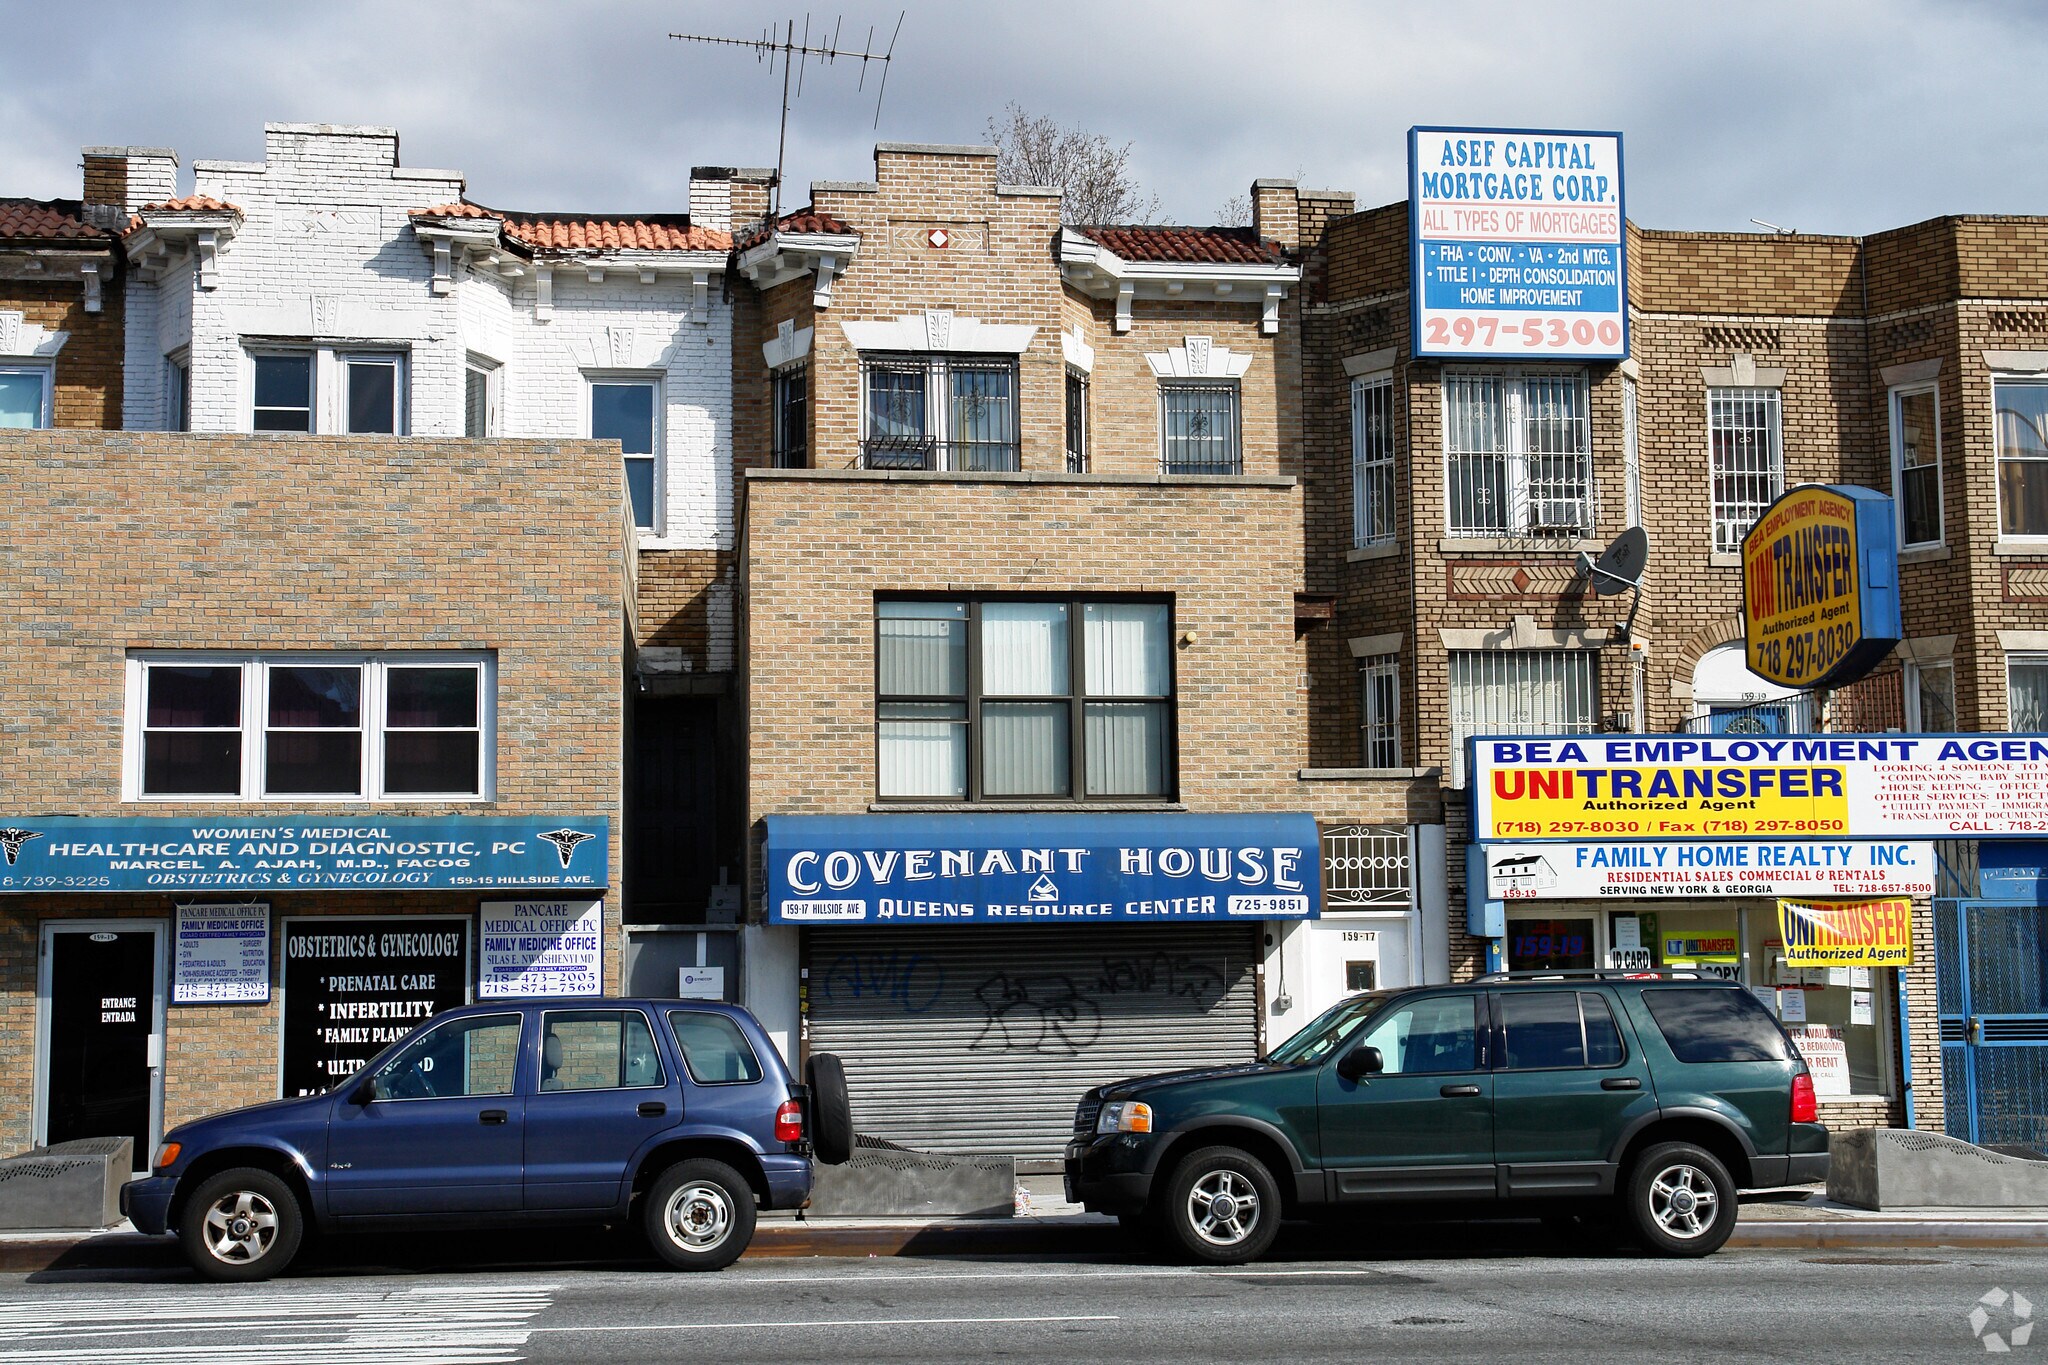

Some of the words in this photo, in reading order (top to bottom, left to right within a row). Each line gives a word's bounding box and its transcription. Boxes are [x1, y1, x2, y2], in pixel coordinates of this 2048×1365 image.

[1440, 139, 1496, 167] ASEF
[1504, 141, 1595, 170] CAPITAL
[1421, 172, 1543, 200] MORTGAGE
[1552, 174, 1616, 203] CORP.
[1423, 209, 1449, 231] ALL
[1453, 210, 1499, 233] TYPES
[1505, 211, 1524, 233] OF
[1530, 211, 1617, 235] MORTGAGES
[1440, 246, 1464, 262] FHA
[1477, 246, 1515, 263] CONV.
[1528, 247, 1544, 263] VA
[1557, 248, 1579, 265] 2nd
[1583, 248, 1611, 265] MTG.
[1437, 266, 1468, 283] TITLE
[1489, 267, 1520, 284] DEPTH
[1523, 268, 1616, 286] CONSOLIDATION
[1460, 288, 1495, 304] HOME
[1500, 289, 1583, 306] IMPROVEMENT
[1425, 316, 1621, 347] 297-5300
[1749, 534, 1765, 555] BEA
[1765, 500, 1816, 537] EMPLOYMENT
[1818, 500, 1850, 523] AGENCY
[1749, 524, 1853, 622] UNITRANSFER
[1762, 611, 1815, 636] Authorized
[1820, 602, 1850, 621] Agent
[1756, 639, 1781, 676] 718
[1785, 621, 1854, 679] 297-8030
[1493, 742, 1588, 763] BEA
[1606, 741, 1919, 762] EMPLOYMENT
[1937, 741, 2048, 761] AGEN
[1874, 764, 1932, 772] LOOKING
[1951, 763, 2015, 772] SOMEONE
[2021, 763, 2038, 771] TO
[1888, 773, 1962, 781] COMPANIONS
[1494, 768, 1843, 800] UNITRANSFER
[1889, 783, 1925, 791] HOUSE
[1931, 783, 1981, 791] KEEPING
[2000, 782, 2040, 790] OFFICE
[1874, 793, 1920, 801] OTHER
[1926, 792, 1989, 800] SERVICES:
[1996, 792, 2010, 800] ID
[1583, 800, 1688, 810] Authorized
[1699, 800, 1756, 811] Agent
[1938, 802, 1986, 810] PAYMENT
[1891, 812, 1962, 820] TRANSLATION
[192, 827, 295, 839] WOMEN'S
[301, 828, 391, 839] MEDICAL
[1496, 821, 1542, 835] (718)
[1549, 821, 1639, 832] 297-8030
[1659, 821, 1695, 832] Fax
[1703, 820, 1748, 834] (718)
[1754, 820, 1843, 831] 297-8050
[49, 843, 231, 856] HEALTHCARE
[237, 842, 299, 856] AND
[309, 842, 481, 857] DIAGNOSTIC,
[491, 842, 526, 855] PC
[1576, 846, 1668, 867] FAMILY
[1678, 846, 1748, 867] HOME
[1758, 845, 1853, 867] REALTY
[1870, 844, 1916, 866] INC.
[109, 860, 205, 870] MARCEL
[218, 860, 240, 869] A.
[254, 859, 322, 871] AJAH,
[335, 858, 388, 870] M.D.,
[396, 858, 471, 868] FACOG
[786, 848, 1090, 895] COVENANT
[1119, 847, 1304, 892] HOUSE
[147, 872, 272, 885] OBSTETRICS
[276, 872, 292, 885] &
[297, 871, 434, 884] GYNECOLOGY
[449, 876, 493, 885] 159-15
[497, 876, 560, 885] HILLSIDE
[564, 875, 595, 884] AVE.
[1607, 872, 1692, 883] RESIDENTIAL
[1695, 871, 1734, 882] SALES
[1739, 870, 1812, 882] COMMECIAL
[1815, 870, 1825, 881] &
[1829, 870, 1886, 881] RENTALS
[1503, 889, 1537, 898] 159-19
[1600, 885, 1647, 895] SERVING
[1650, 885, 1675, 895] NEW
[1678, 885, 1708, 894] YORK
[1712, 885, 1721, 894] &
[1725, 885, 1773, 894] GEORGIA
[1833, 884, 1854, 893] TEL:
[1858, 883, 1932, 893] 718-657-8500
[514, 904, 568, 916] PANCARE
[786, 903, 809, 915] 159-17
[812, 903, 843, 914] HILLSIDE
[847, 903, 862, 914] AVE.
[877, 899, 974, 918] QUEENS
[987, 903, 1113, 916] RESOURCE
[1125, 895, 1216, 915] CENTER
[1235, 899, 1302, 910] 725-9851
[180, 907, 208, 917] PANCARE
[209, 907, 235, 917] MEDICAL
[236, 907, 255, 916] OFFICE
[255, 907, 266, 916] PC
[181, 921, 205, 930] FAMILY
[206, 920, 239, 930] MEDICINE
[240, 920, 264, 929] OFFICE
[484, 920, 537, 932] MEDICAL
[540, 920, 579, 932] OFFICE
[583, 919, 597, 931] PC
[1783, 902, 1907, 946] UNITRANSFER
[1342, 931, 1375, 941] 159-17
[289, 935, 366, 958] OBSTETRICS
[367, 934, 376, 957] &
[380, 932, 459, 957] GYNECOLOGY
[484, 937, 516, 951] FAMILY
[519, 937, 562, 951] MEDICINE
[564, 937, 597, 950] OFFICE
[1514, 935, 1585, 957] 159-19
[1685, 939, 1735, 951] UNITRANSFER
[487, 955, 511, 965] SILAS
[580, 954, 594, 963] MD
[1612, 950, 1621, 969] ID
[1624, 950, 1649, 969] CARD
[1788, 947, 1864, 959] Authorized
[1867, 947, 1907, 961] Agent
[182, 960, 206, 968] PEDIATRICS
[329, 975, 397, 992] PRENATAL
[401, 974, 436, 990] CARE
[485, 972, 595, 983] 718-473-2005
[178, 983, 265, 991] 718-473-2005
[485, 983, 596, 994] 718-874-7569
[178, 991, 265, 999] 718-874-7569
[101, 997, 137, 1008] ENTRANCE
[101, 1011, 136, 1023] ENTRADA
[329, 1001, 435, 1020] INFERTILITY
[324, 1027, 369, 1043] FAMILY
[1804, 1028, 1842, 1039] AVAILABLE
[1806, 1041, 1844, 1051] BEDROOMS
[1815, 1057, 1838, 1068] RENT
